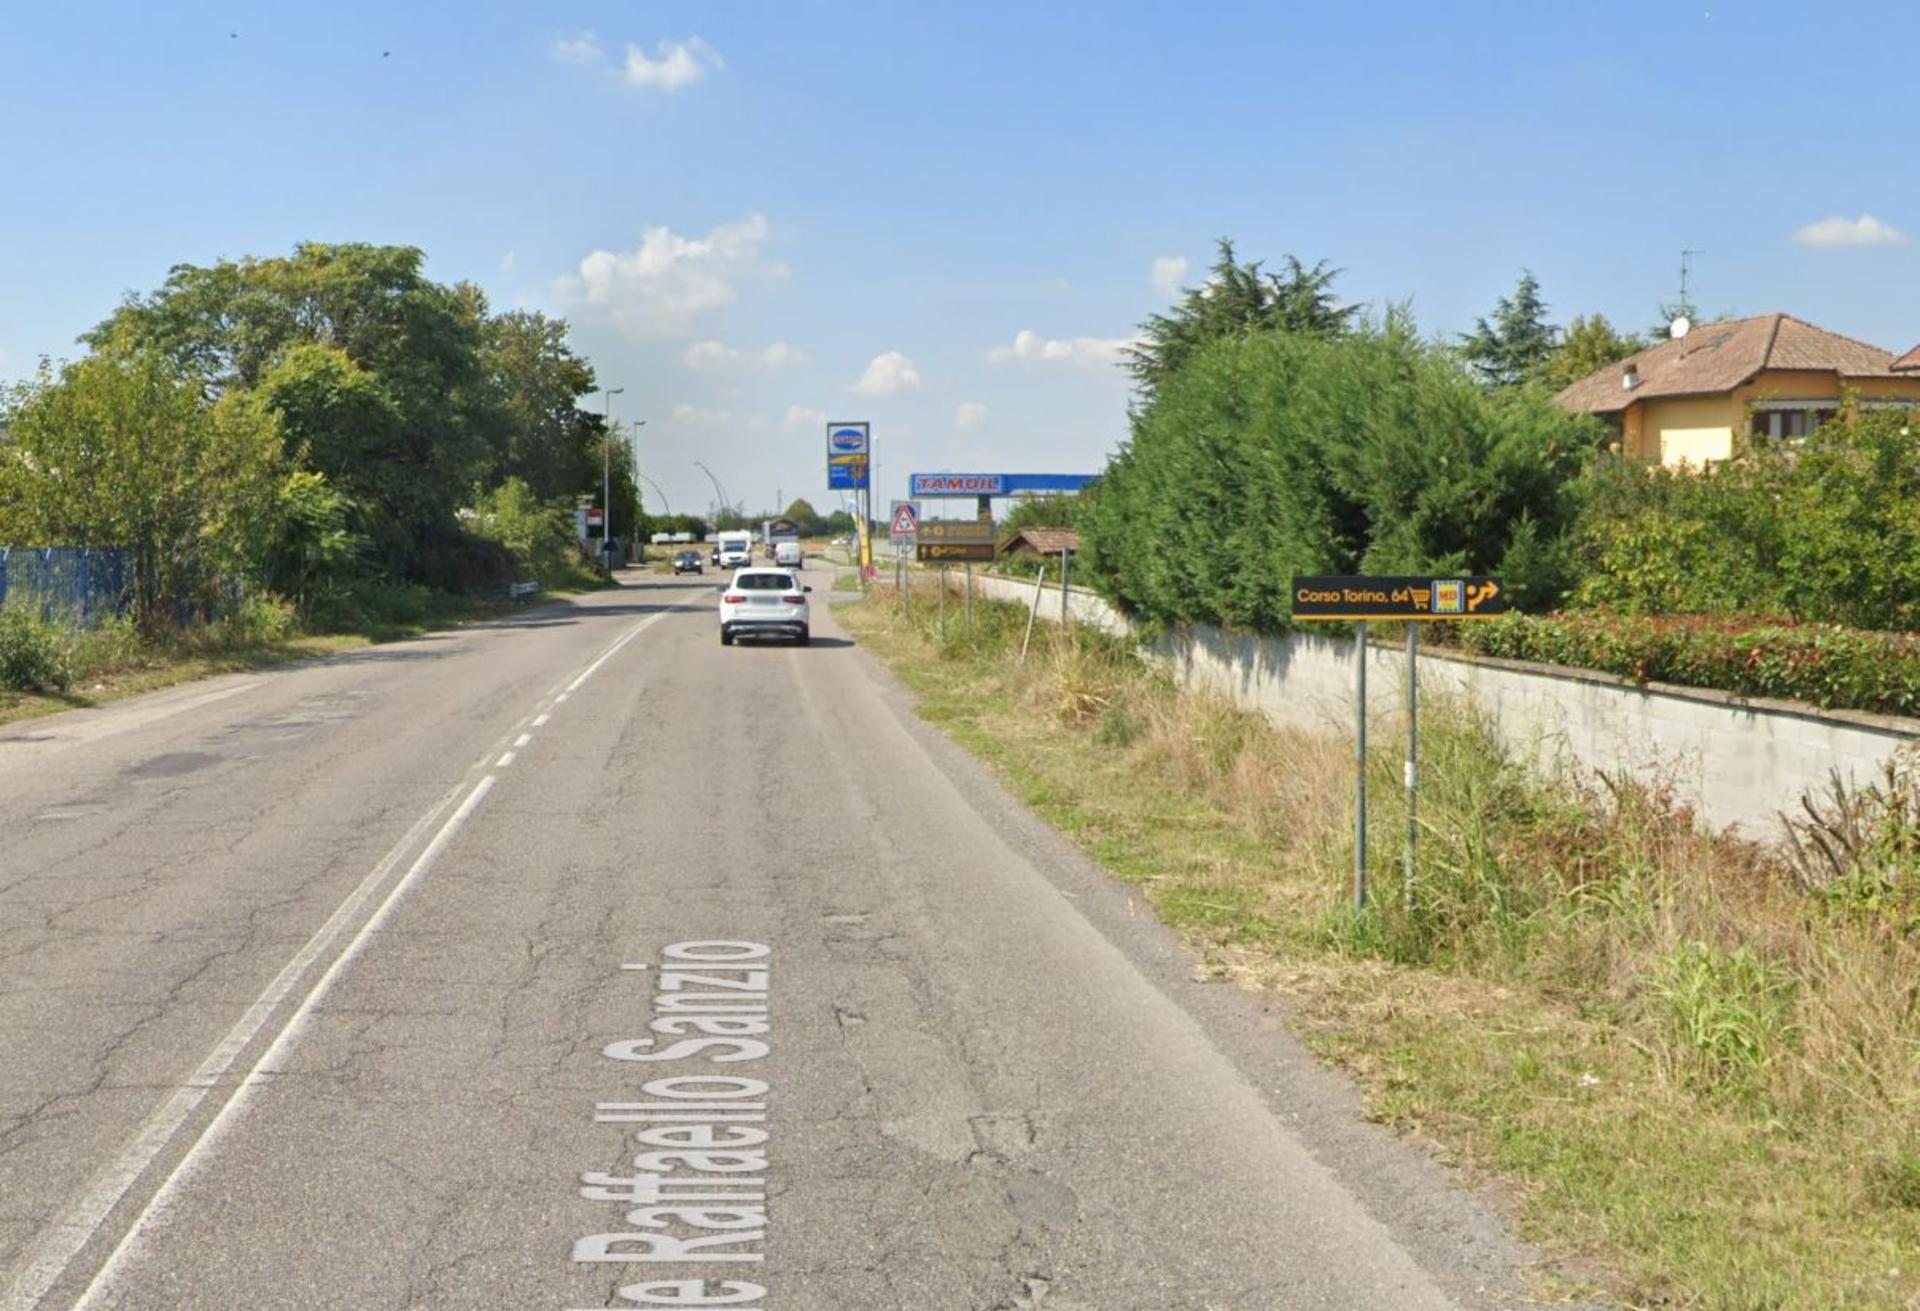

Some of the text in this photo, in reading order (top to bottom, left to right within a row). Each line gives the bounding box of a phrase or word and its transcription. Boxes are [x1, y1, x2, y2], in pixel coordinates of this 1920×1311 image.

[918, 478, 997, 490] TAMOIL
[1297, 589, 1341, 602] Corso
[1391, 589, 1409, 602] 64
